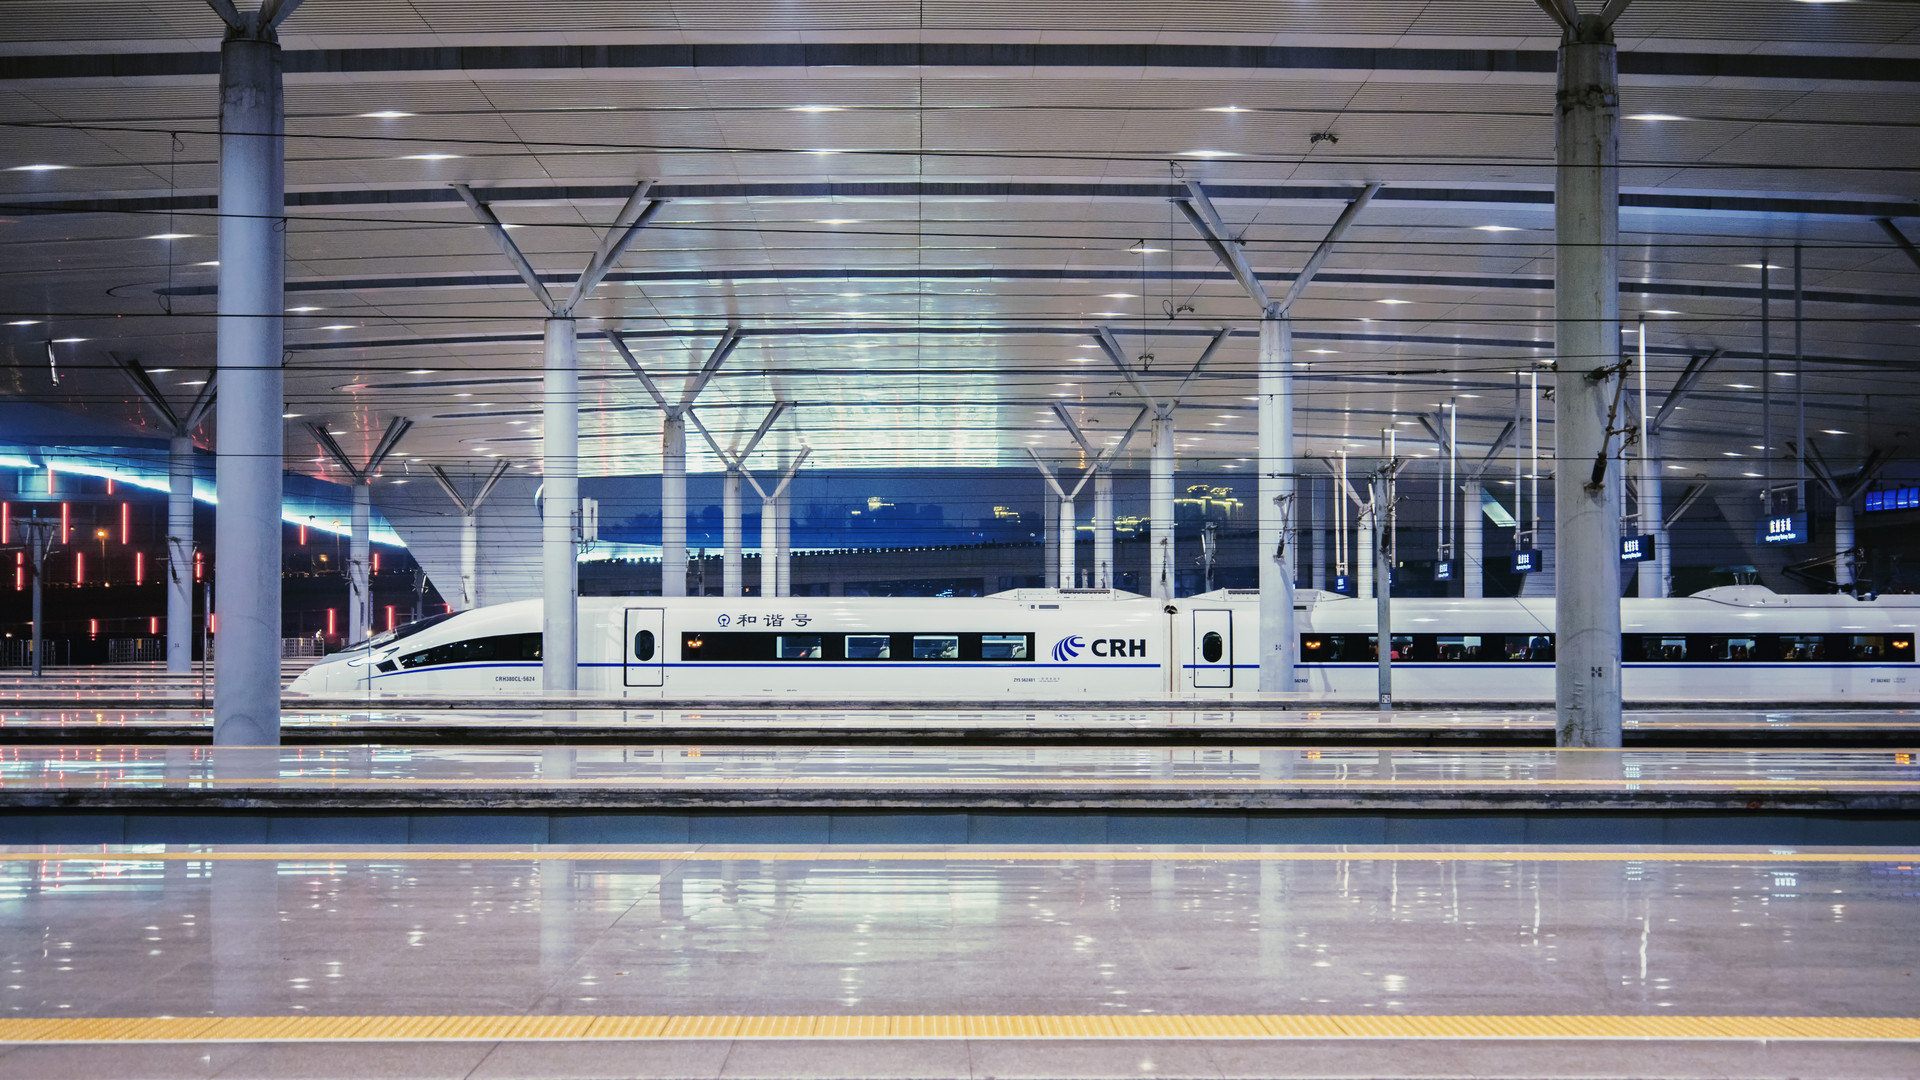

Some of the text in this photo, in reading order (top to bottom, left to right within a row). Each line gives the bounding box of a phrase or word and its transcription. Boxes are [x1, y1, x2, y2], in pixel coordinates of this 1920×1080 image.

[736, 613, 813, 627] 和谐号
[1091, 638, 1146, 657] CRH
